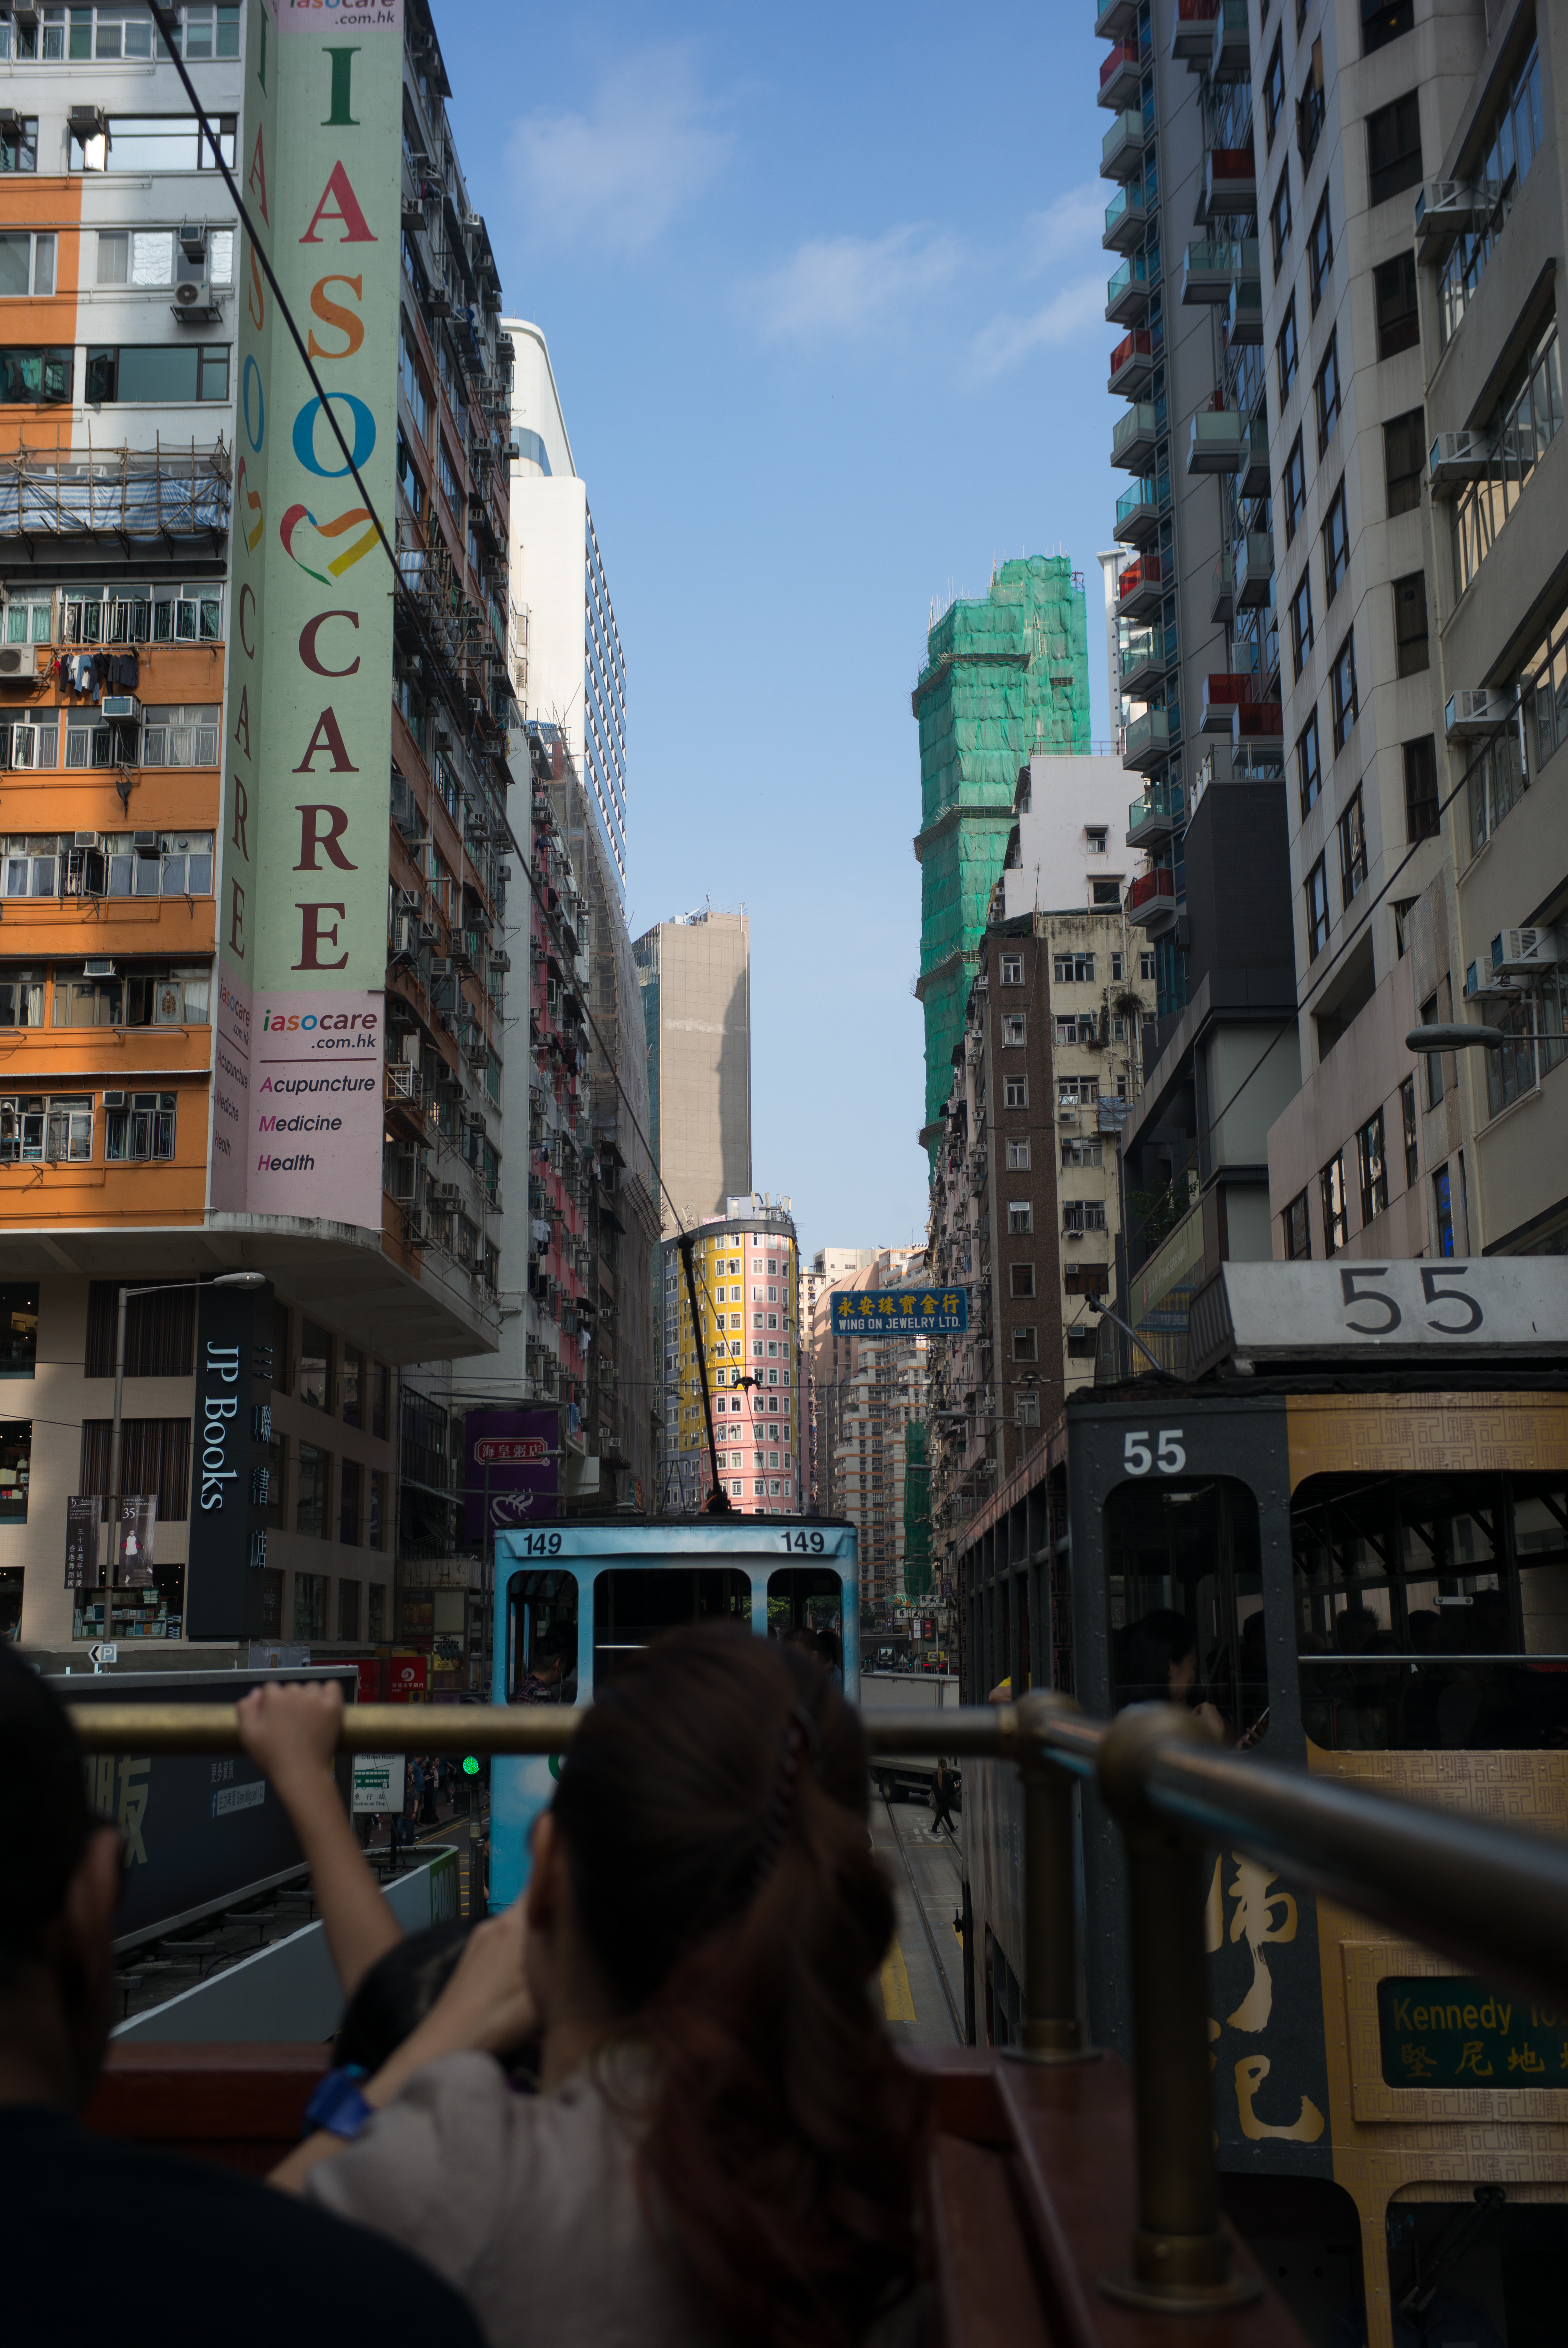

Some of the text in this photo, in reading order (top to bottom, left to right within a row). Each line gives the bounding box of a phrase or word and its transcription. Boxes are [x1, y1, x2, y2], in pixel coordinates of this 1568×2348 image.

[335, 11, 395, 24] .com.hk
[220, 977, 250, 1027] iasocare
[263, 1009, 377, 1031] iasocare
[311, 1034, 376, 1049] .com.hk
[217, 1049, 248, 1089] Acupuncture
[260, 1075, 375, 1095] Acupuncture
[216, 1089, 239, 1121] Medicine
[259, 1115, 342, 1132] Medicine
[214, 1130, 231, 1157] Health
[258, 1154, 314, 1171] Health
[838, 1294, 960, 1317] 永安珠寶金行
[1340, 1266, 1483, 1334] 55
[839, 1316, 961, 1330] WING ON JEWELRY LTD.
[201, 1341, 240, 1510] JP Books
[482, 1444, 542, 1457] 海皇粥店
[1124, 1429, 1186, 1475] 55
[123, 1508, 135, 1519] 35
[524, 1533, 562, 1555] 149
[781, 1532, 825, 1553] 149
[103, 1648, 112, 1660] P
[211, 1760, 234, 1783] 更多資訊
[245, 1787, 257, 1805] Miguel
[1392, 1996, 1511, 2035] Kennedy
[1401, 2040, 1568, 2078] 堅尼地
